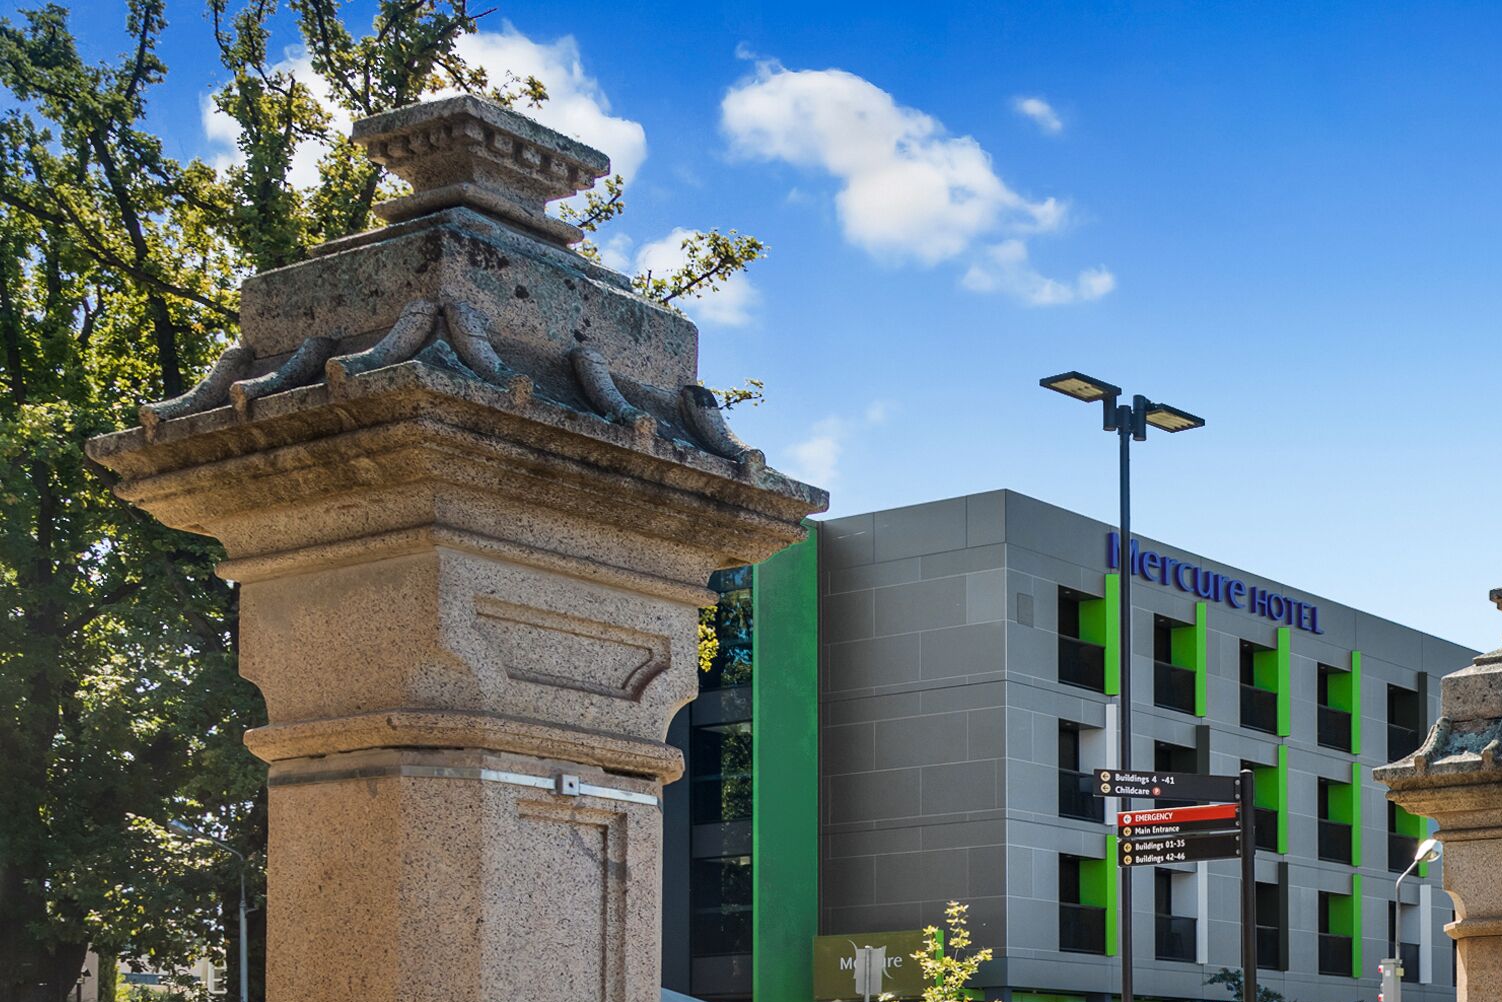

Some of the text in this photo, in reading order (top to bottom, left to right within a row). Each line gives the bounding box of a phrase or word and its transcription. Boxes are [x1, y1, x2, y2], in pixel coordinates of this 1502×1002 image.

[1105, 531, 1325, 635] Mercure HOTEL
[1115, 773, 1150, 785] Buildings
[1161, 776, 1175, 785] -41
[1115, 785, 1150, 795] Childcare
[1135, 812, 1174, 822] EMERGENCY
[1135, 825, 1180, 835] Main Entrance
[1135, 839, 1186, 852] Buildings 01-35
[1135, 852, 1186, 865] Buildings 42-46
